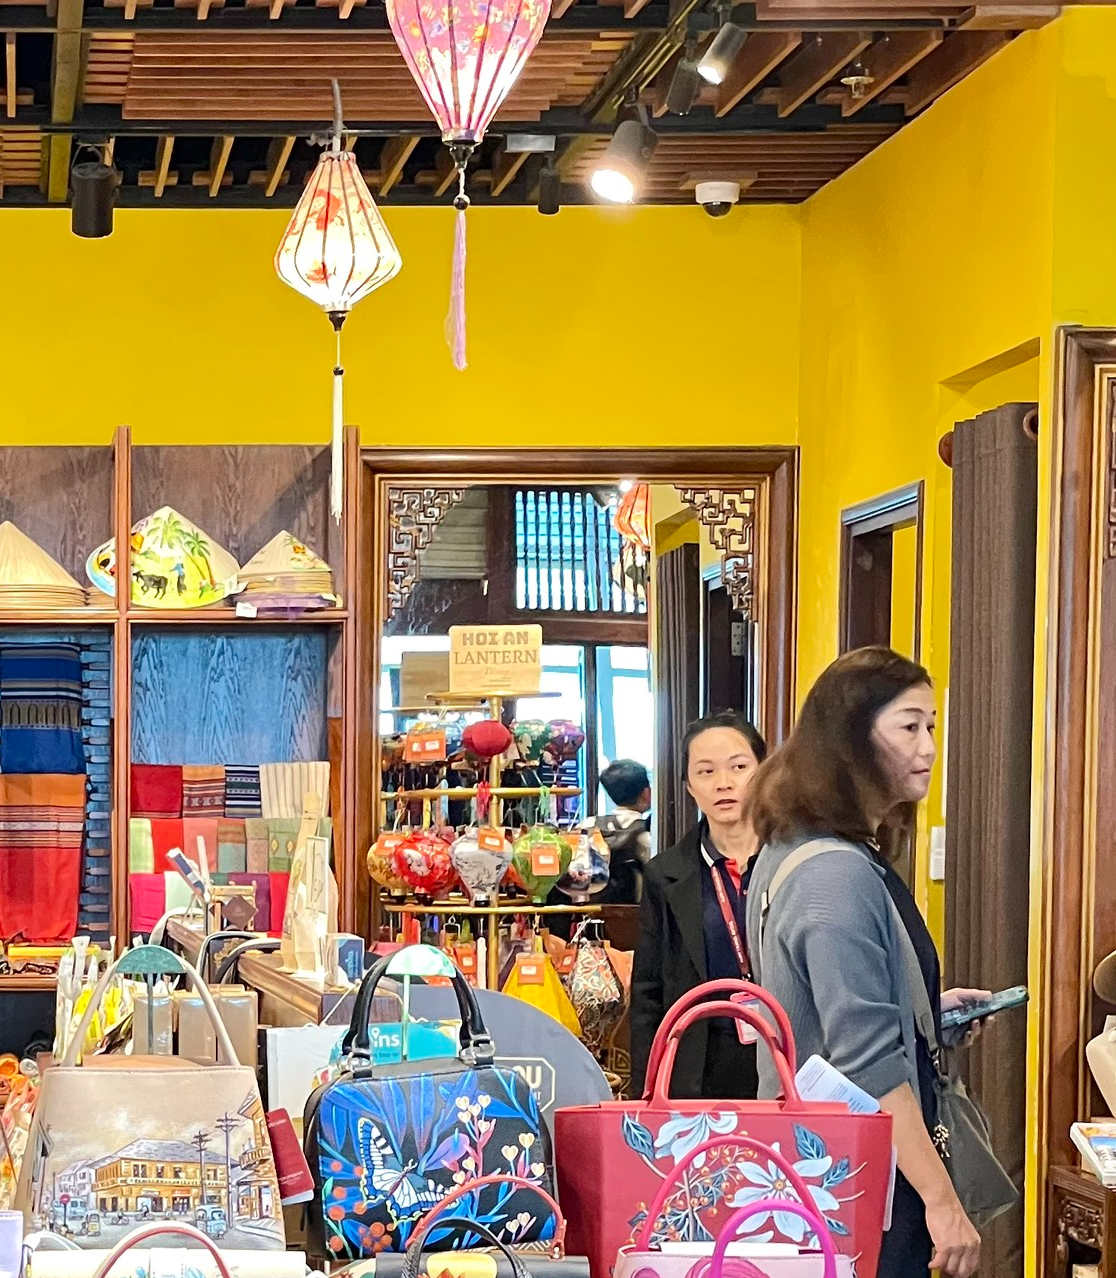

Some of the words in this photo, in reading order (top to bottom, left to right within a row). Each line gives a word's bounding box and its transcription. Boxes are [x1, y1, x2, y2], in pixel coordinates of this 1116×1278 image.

[462, 632, 499, 646] HOI
[503, 631, 529, 645] AN
[454, 649, 538, 665] LANTERN
